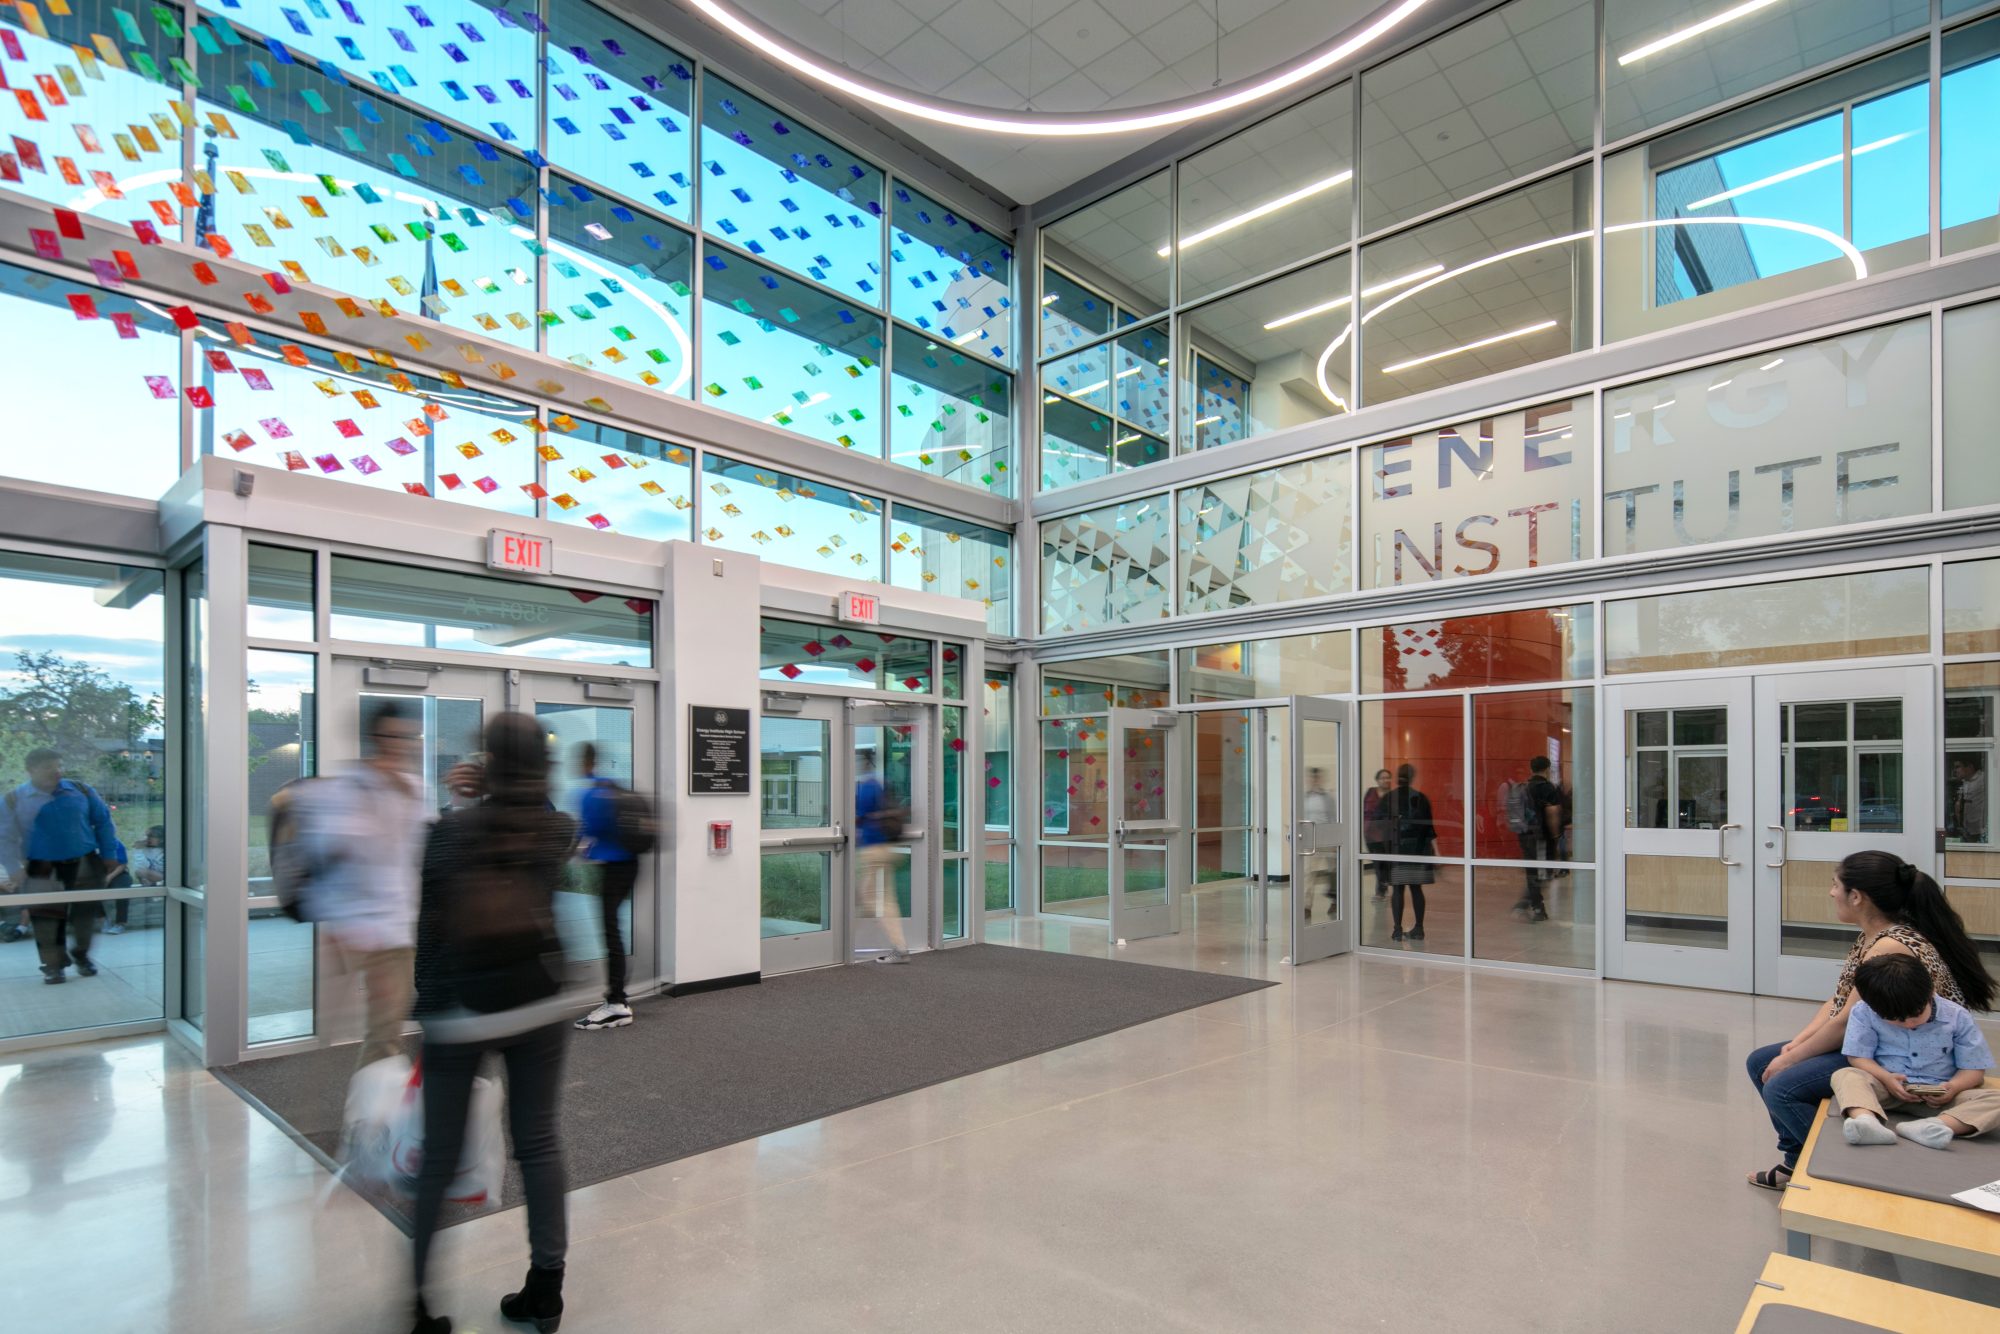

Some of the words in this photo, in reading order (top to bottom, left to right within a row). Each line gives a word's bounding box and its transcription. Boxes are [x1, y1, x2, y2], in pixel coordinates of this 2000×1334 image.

[1373, 326, 1900, 502] ENERGY
[504, 536, 543, 568] EXIT
[1375, 442, 1900, 588] INSTITUTE
[851, 597, 874, 620] EXIT
